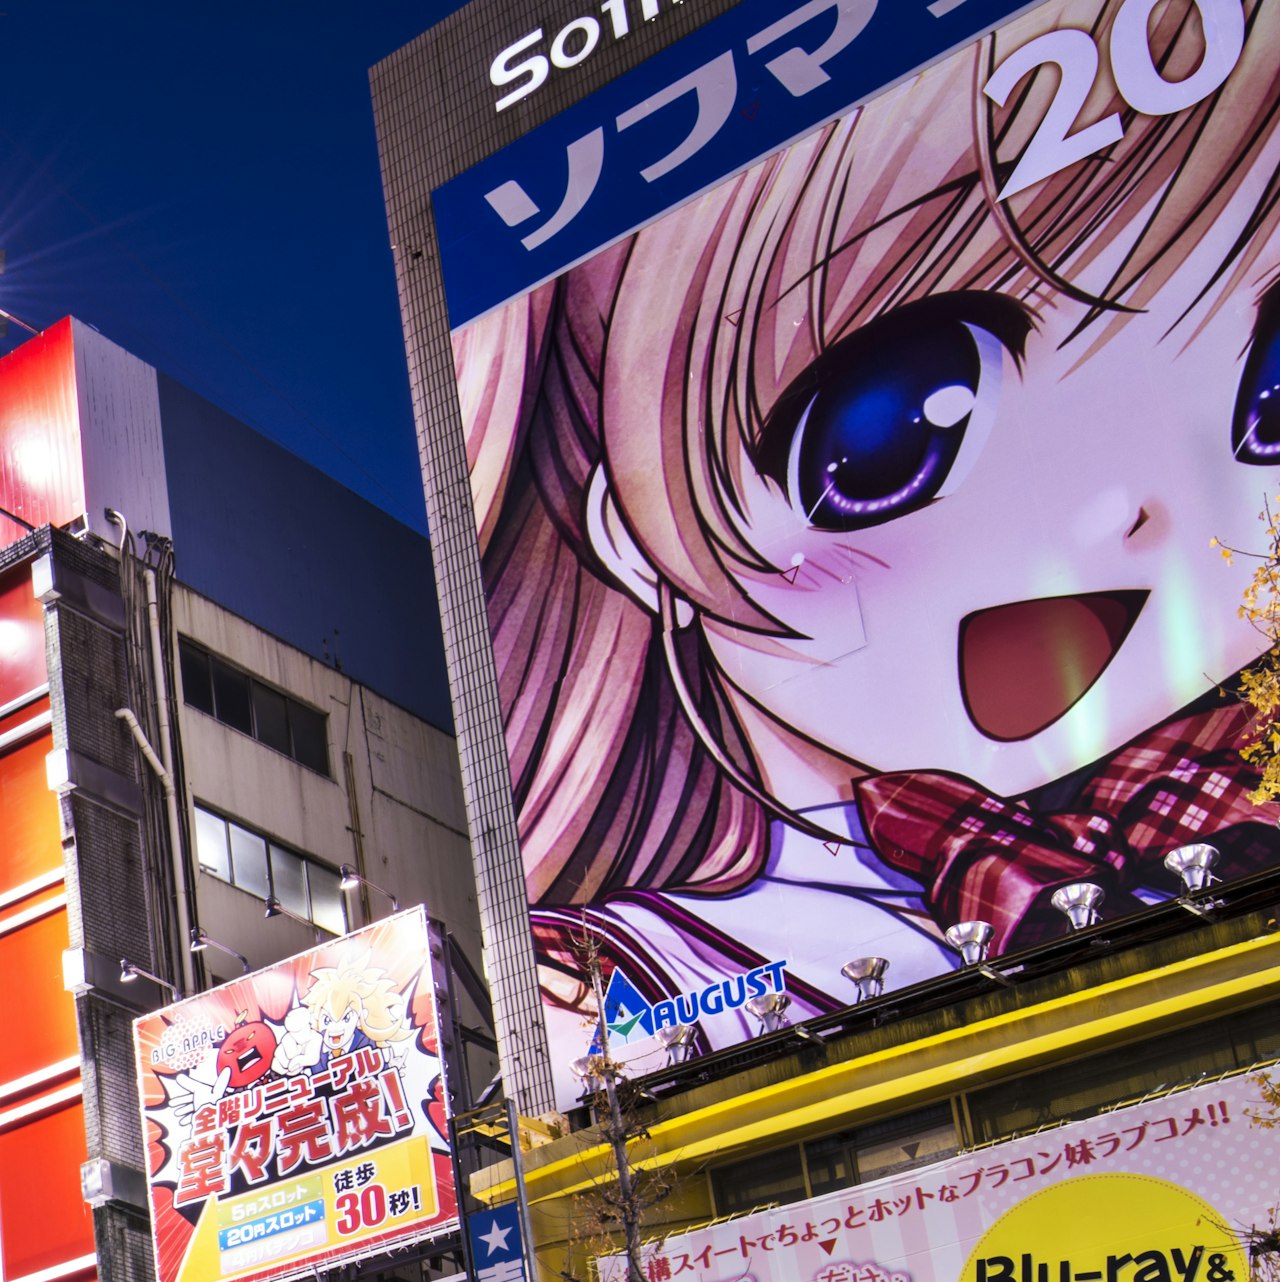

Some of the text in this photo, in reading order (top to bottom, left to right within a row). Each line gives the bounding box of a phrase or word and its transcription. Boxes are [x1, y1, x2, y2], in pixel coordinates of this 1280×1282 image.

[652, 960, 788, 1031] AUGUST
[151, 1022, 226, 1065] BIG APPLE
[194, 1046, 384, 1133] 全階リニューアル
[333, 1161, 377, 1195] 徒歩
[225, 1203, 318, 1249] 20円スロット
